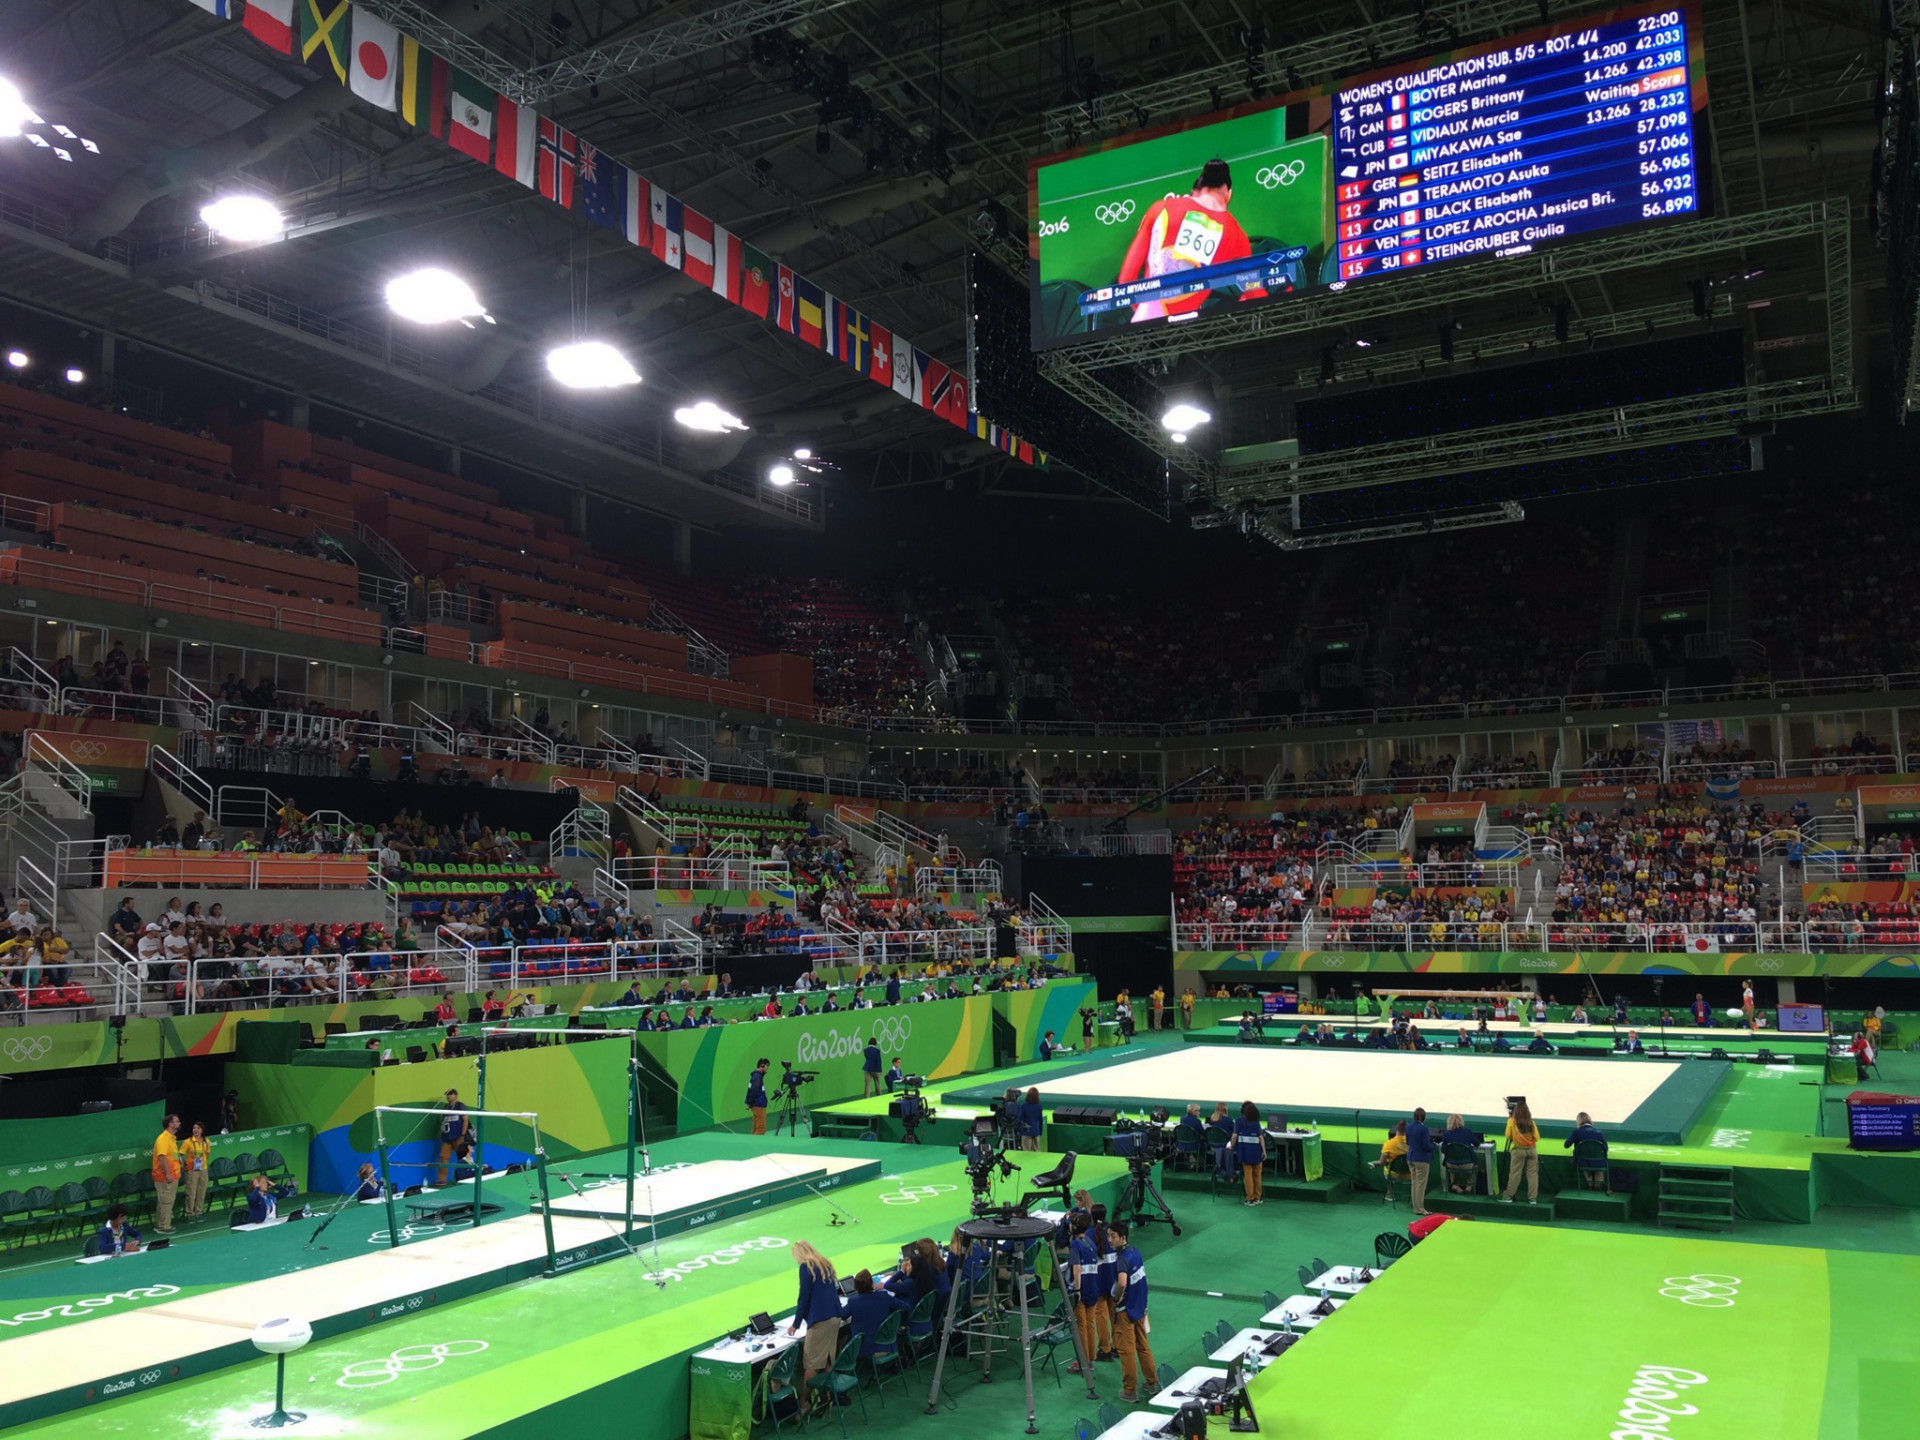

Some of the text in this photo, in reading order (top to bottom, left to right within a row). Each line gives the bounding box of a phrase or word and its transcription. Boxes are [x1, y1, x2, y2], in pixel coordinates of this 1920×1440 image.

[1638, 11, 1679, 32] 22:00
[1339, 80, 1393, 105] WOMEN'S
[1395, 59, 1485, 91] QUALIFICATION
[1487, 52, 1513, 69] SUB.
[1515, 44, 1536, 62] 5/5
[1546, 35, 1575, 55] ROT.
[1577, 29, 1599, 46] 4/4
[1359, 29, 1681, 118] FRA BOYER Marine 14.200 42.033
[1359, 50, 1682, 136] CAN ROGERS Brittany 14.266 42.398
[1360, 74, 1681, 156] CUB VIDIAUX Marcia Waiting Score
[1364, 92, 1685, 176] JPN MIYAKAWA Sae 13.266 28.232
[1345, 111, 1687, 199] 11 GER SEITZ Elisabeth 57.098
[1346, 133, 1689, 218] 12 JPN TERAMOTO Asuka 57.066
[1346, 153, 1690, 238] 13 CAN BLACK Elsabeth 56.965
[1347, 174, 1692, 257] 14 VEN LOPEZ AROCHA Jessica Bri. 56.932
[1178, 229, 1216, 257] 360
[1348, 196, 1693, 276] 15 SUI STEINGRUBER Giulia 56.899
[1127, 279, 1161, 294] MIYAKAWA
[83, 777, 104, 787] SÍDA
[1519, 957, 1557, 968] Rio2016
[798, 1026, 863, 1063] Rio2016
[642, 1236, 789, 1282] Rio2016
[381, 1303, 405, 1317] Rio2016
[103, 1377, 136, 1395] Rio2016
